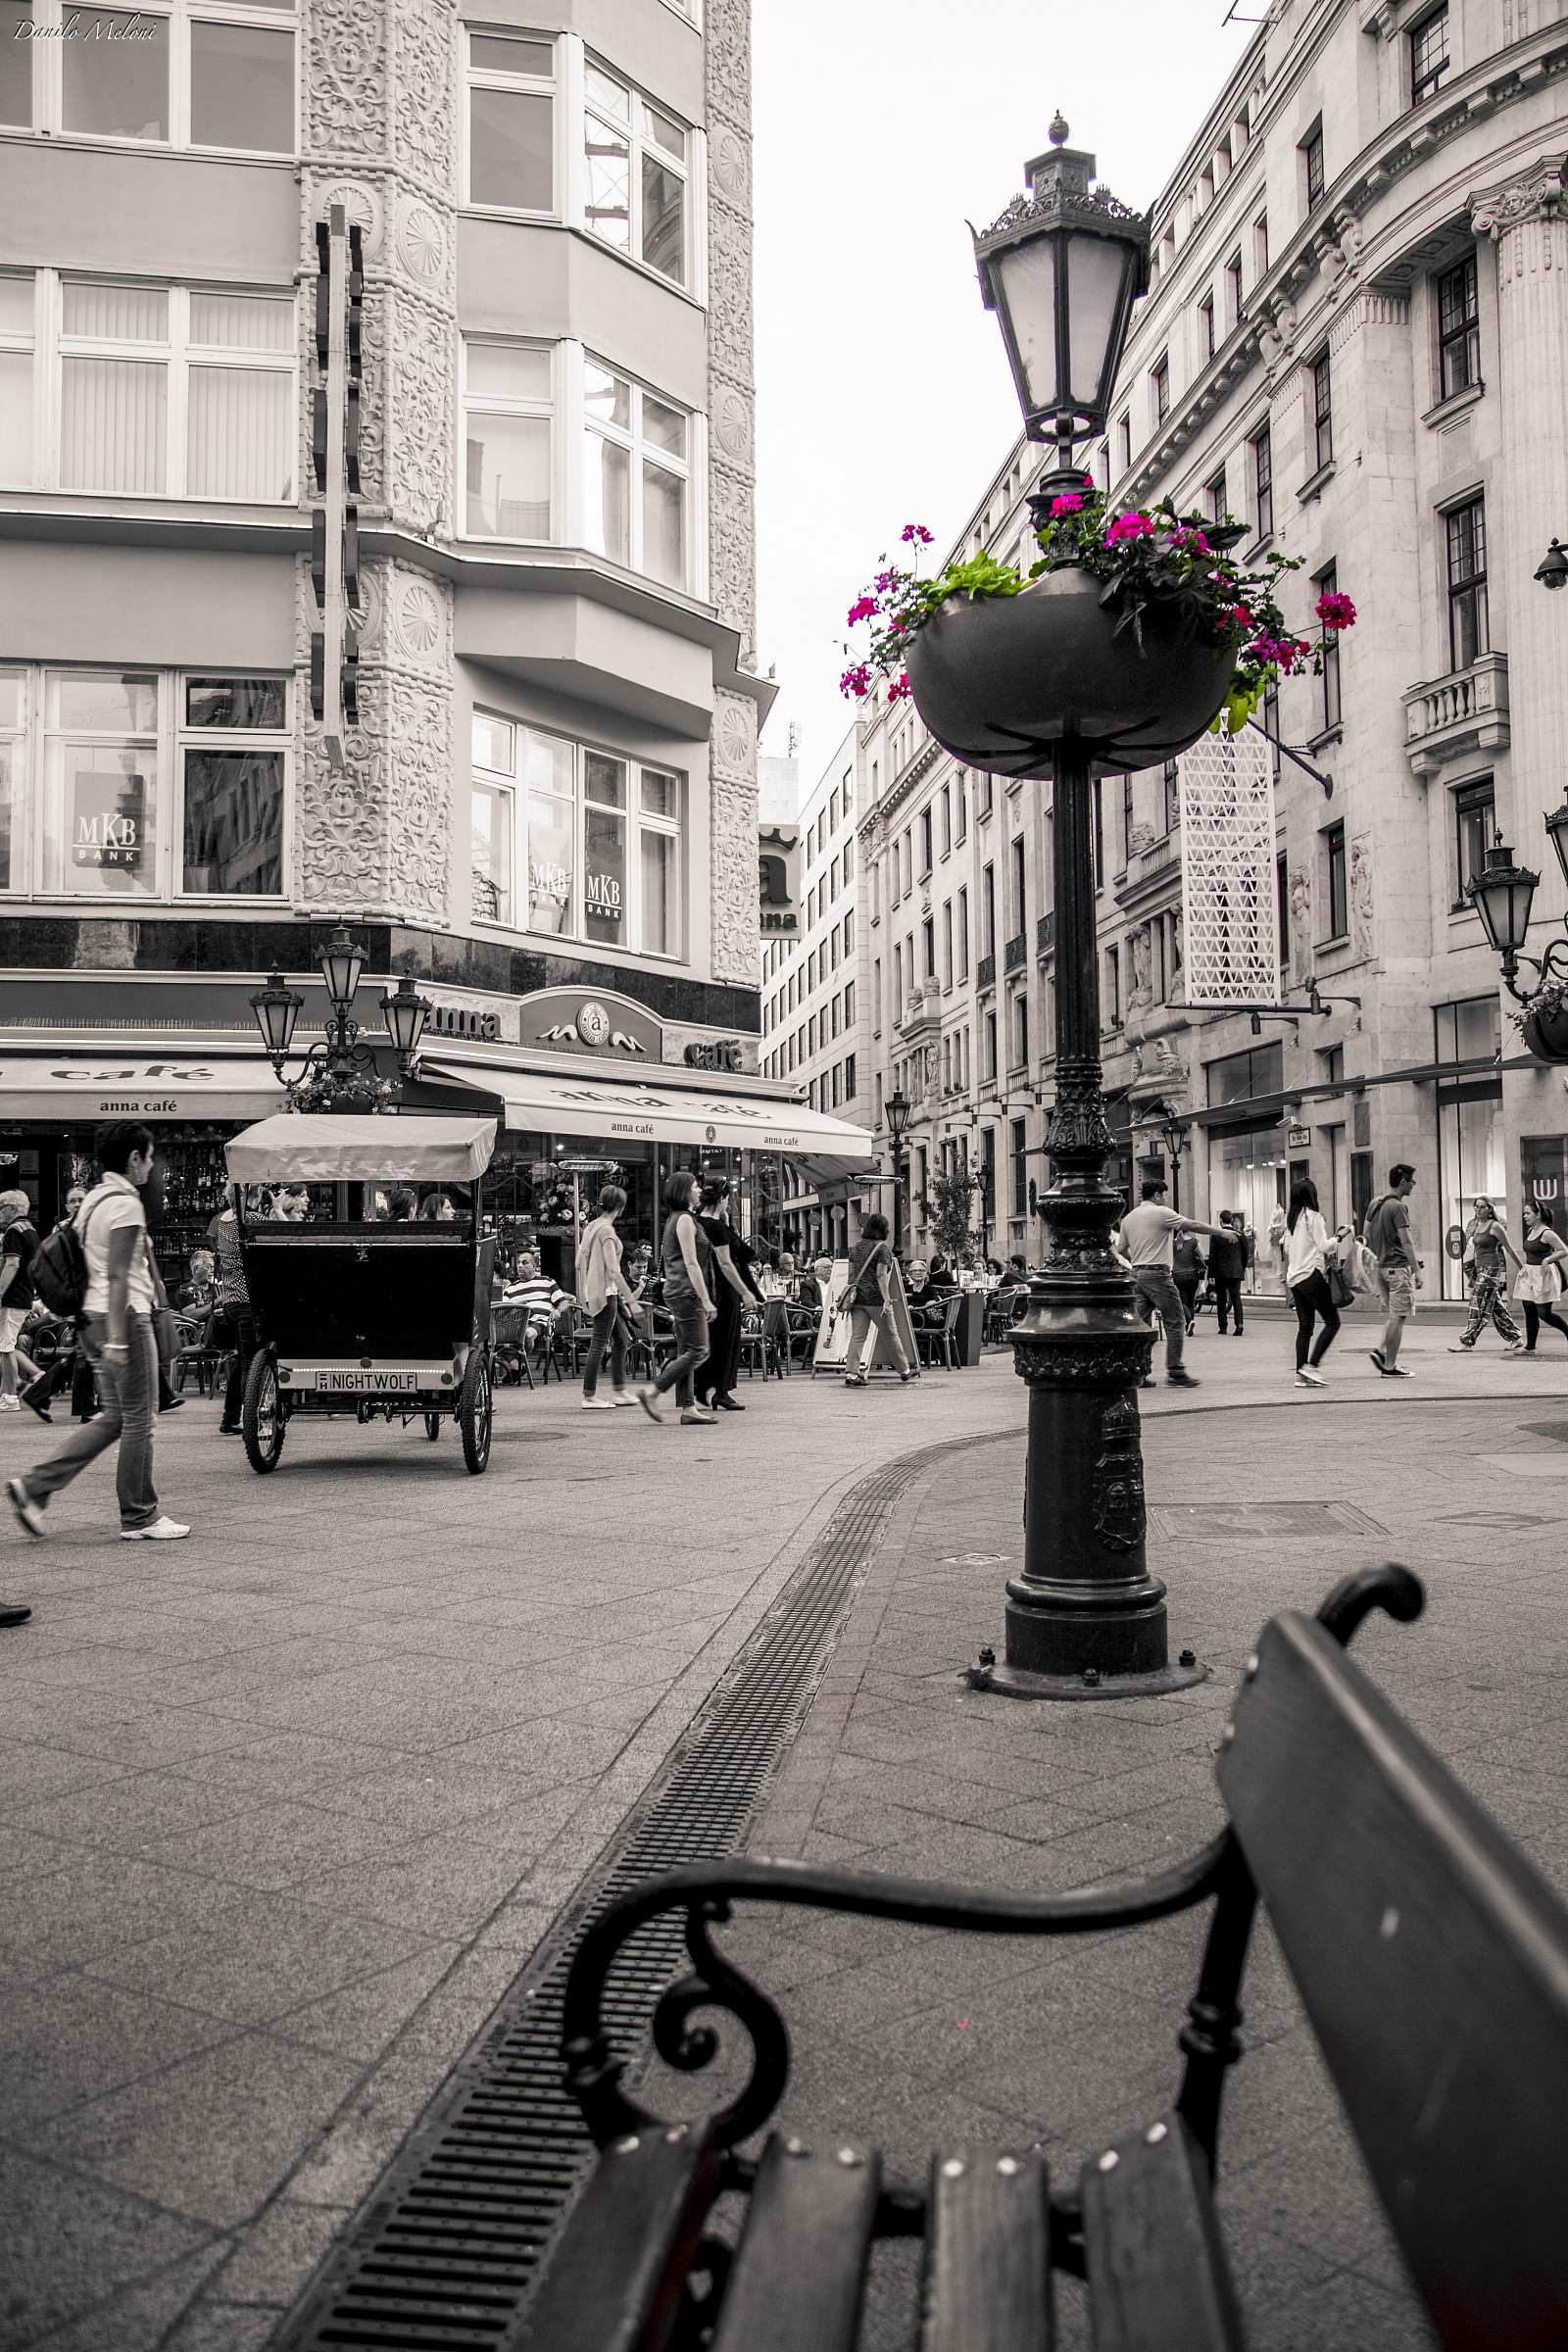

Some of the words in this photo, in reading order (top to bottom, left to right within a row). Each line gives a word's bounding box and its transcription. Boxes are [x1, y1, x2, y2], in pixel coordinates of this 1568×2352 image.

[78, 812, 136, 847] MKB
[79, 850, 134, 861] BANK
[532, 861, 566, 893] MKB
[588, 874, 620, 906] MKB
[588, 904, 619, 919] BANK
[422, 1005, 503, 1039] anna
[592, 1017, 601, 1030] a
[688, 1039, 743, 1070] café
[50, 1064, 216, 1081] café
[100, 1102, 139, 1112] anna
[144, 1100, 177, 1112] café
[549, 1089, 674, 1107] anna
[612, 1123, 633, 1133] anna
[636, 1124, 654, 1134] café
[764, 1136, 782, 1145] anna
[784, 1137, 800, 1147] café
